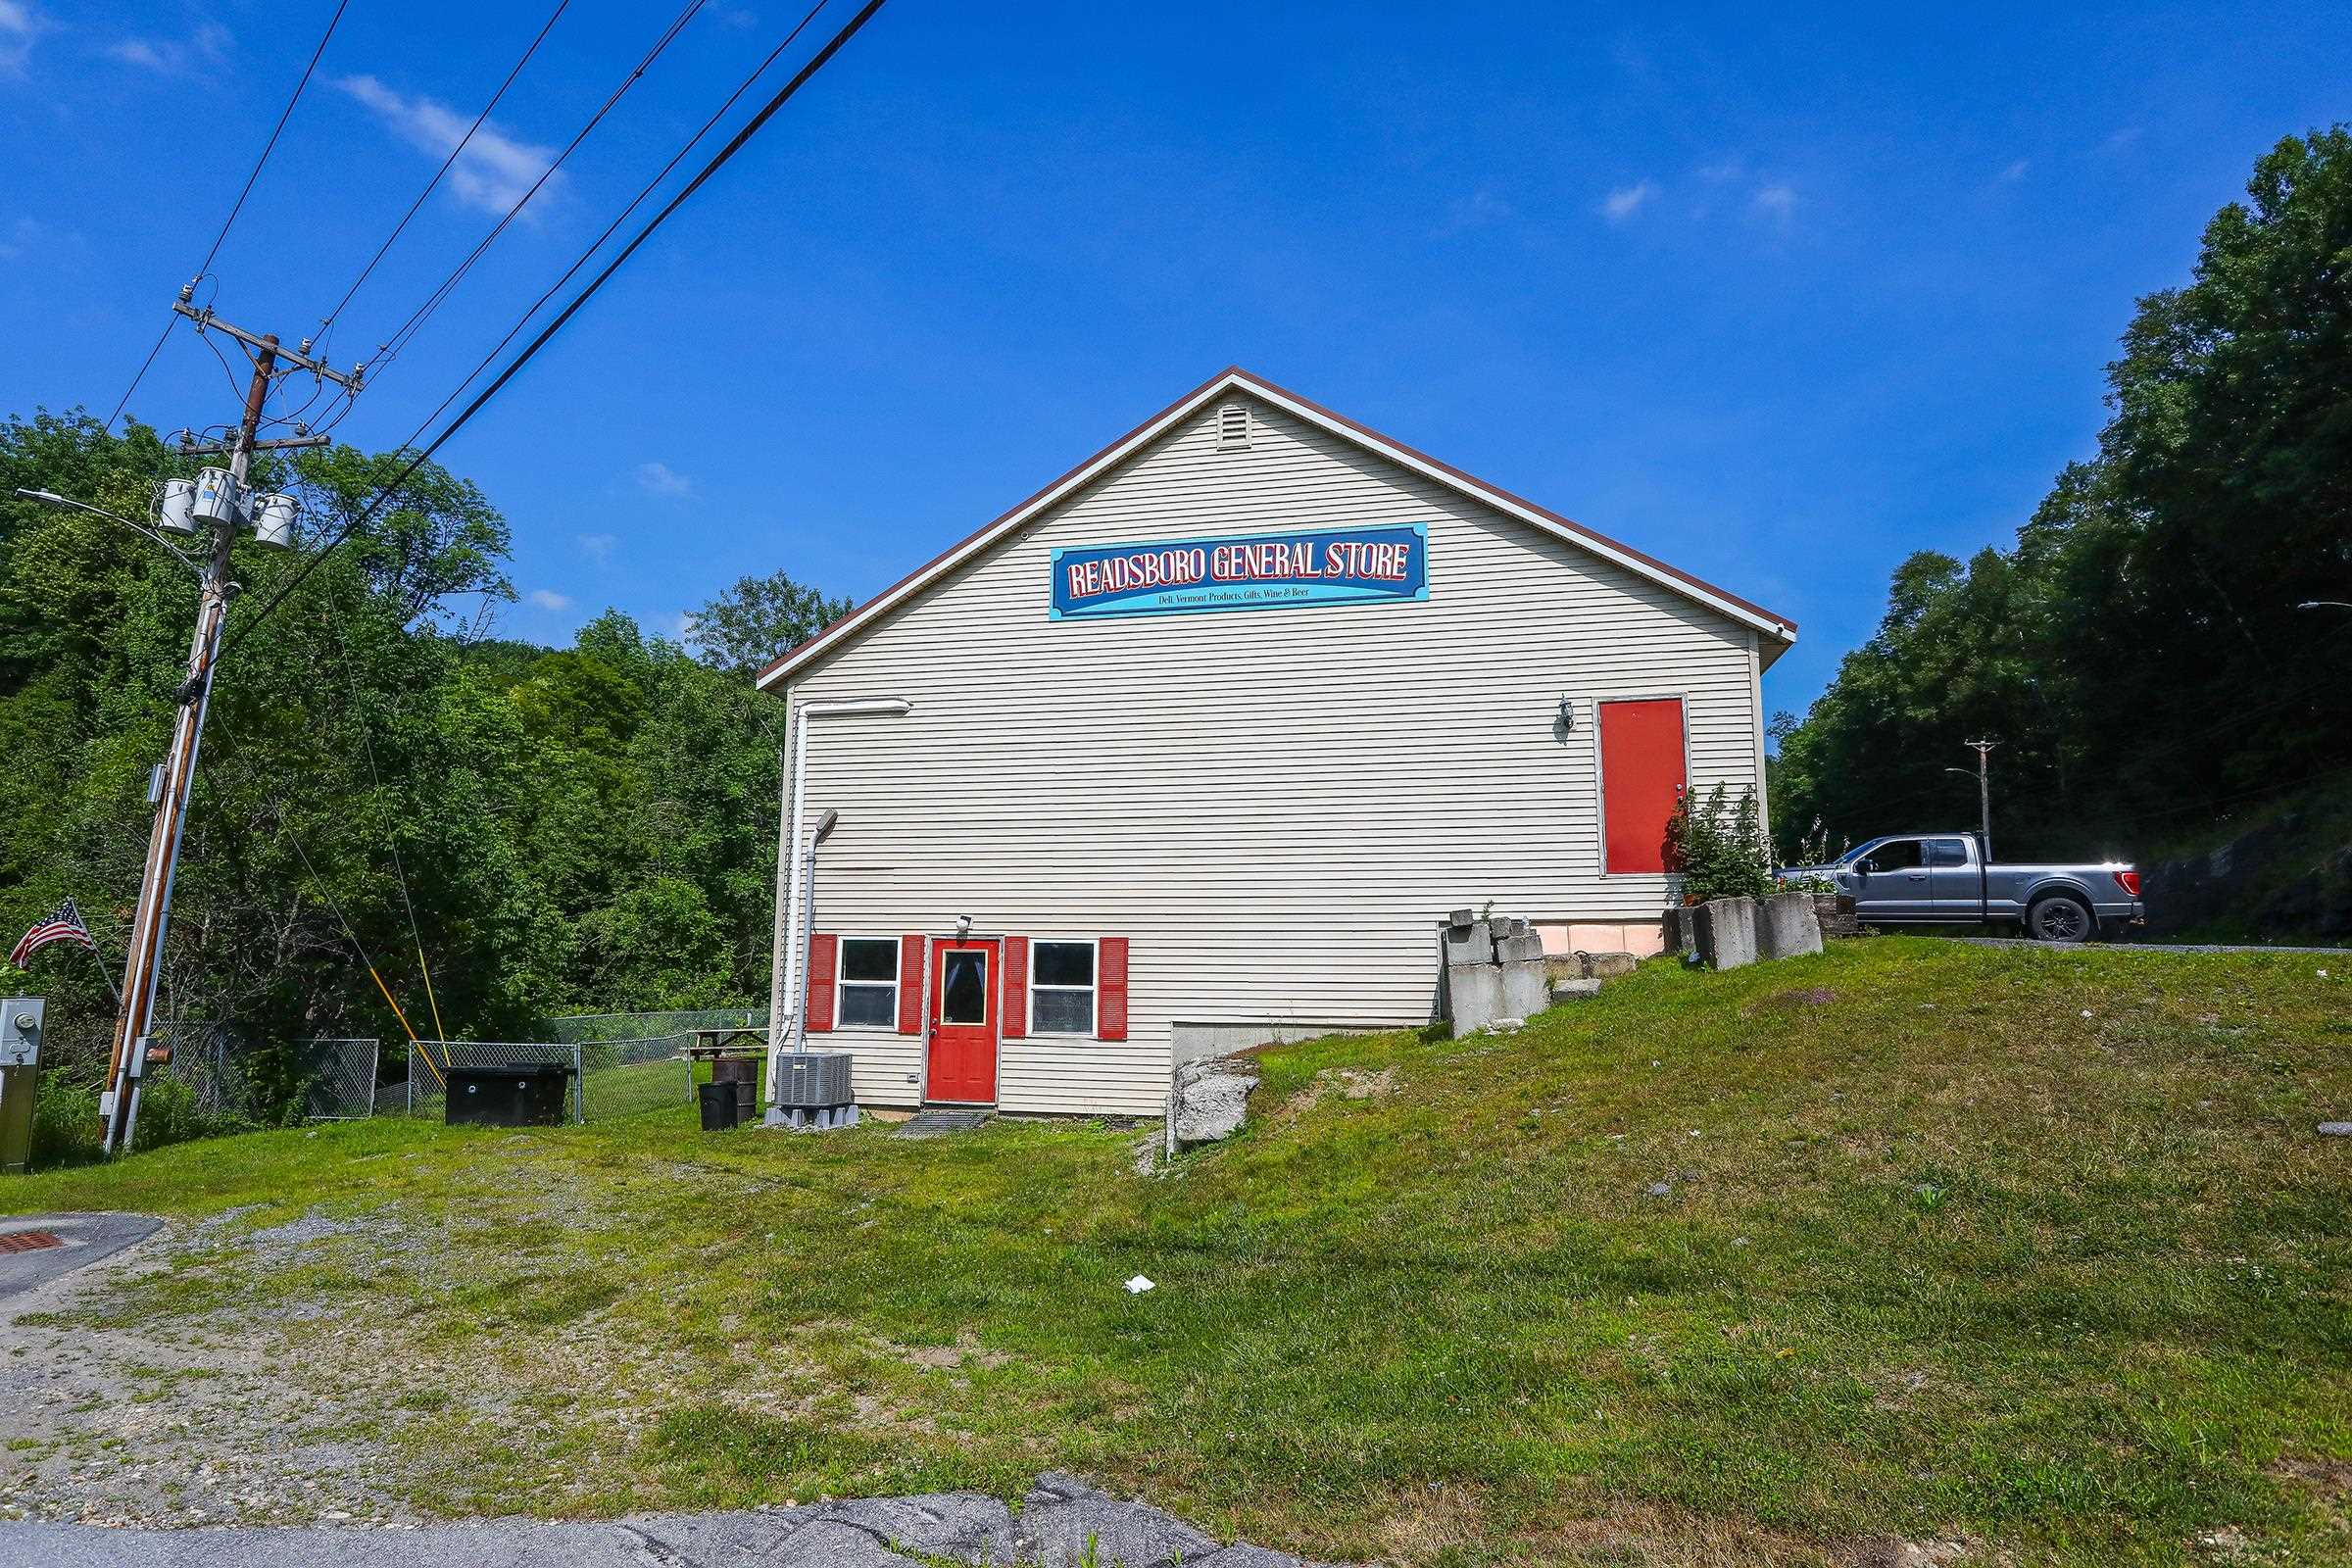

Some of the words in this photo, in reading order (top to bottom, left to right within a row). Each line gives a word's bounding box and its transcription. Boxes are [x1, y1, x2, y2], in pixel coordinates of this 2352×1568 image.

[1067, 547, 1205, 600] READSBORO
[1210, 542, 1321, 581] GENERAL
[1325, 542, 1410, 581] STORE
[1176, 593, 1206, 604] Vermont
[1263, 588, 1282, 599] Wine
[1283, 588, 1291, 598] &
[1292, 587, 1309, 597] Beer
